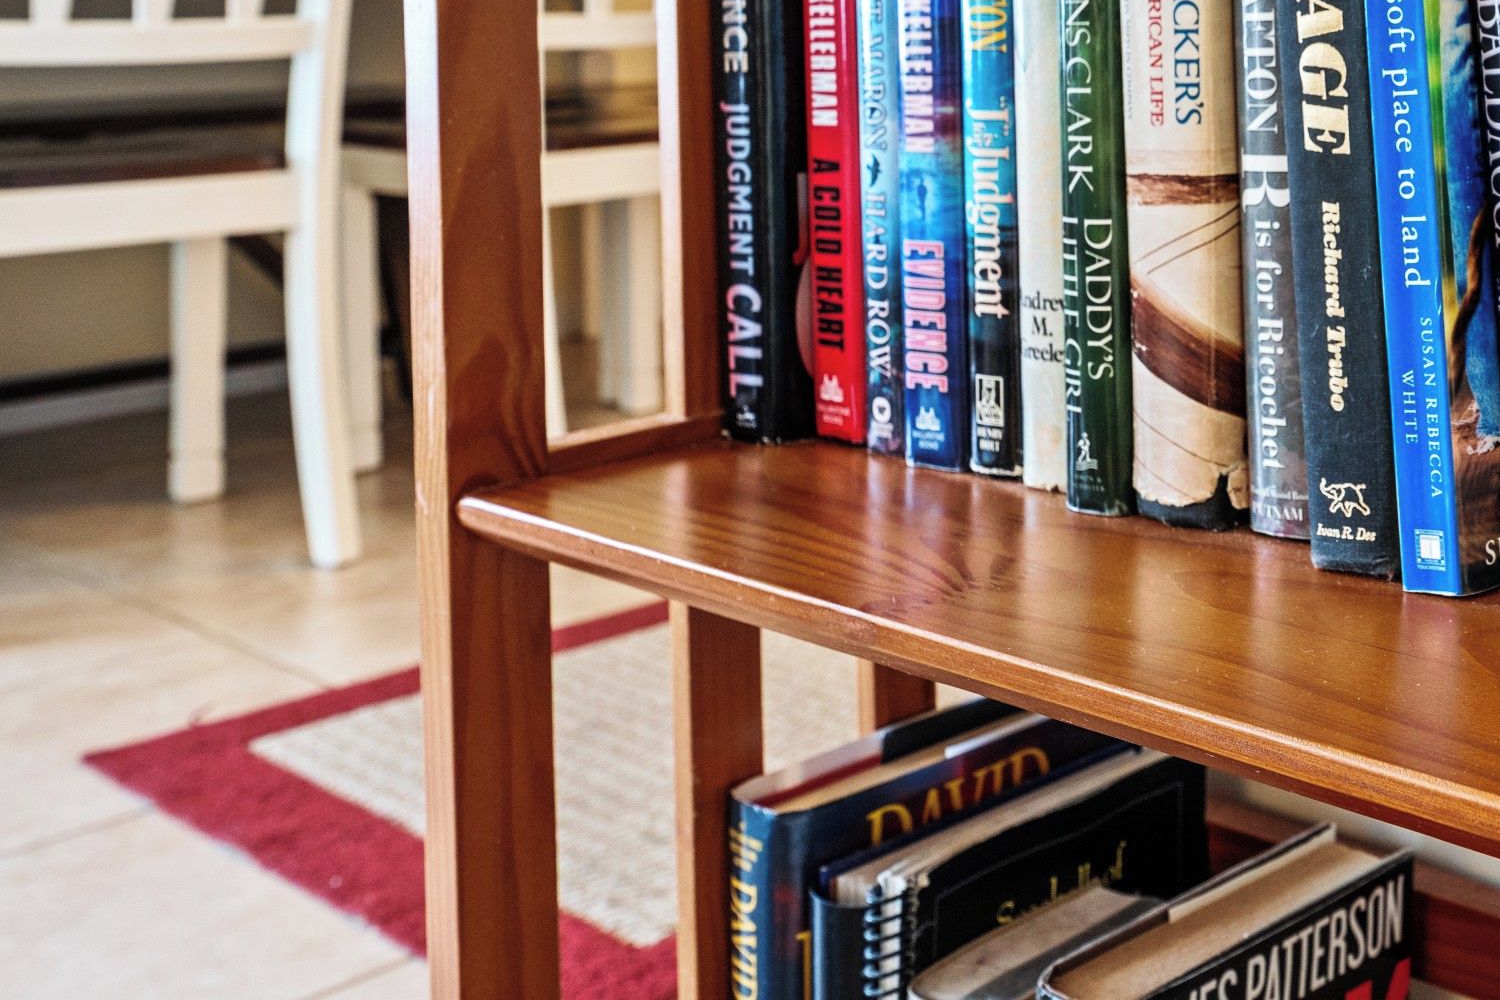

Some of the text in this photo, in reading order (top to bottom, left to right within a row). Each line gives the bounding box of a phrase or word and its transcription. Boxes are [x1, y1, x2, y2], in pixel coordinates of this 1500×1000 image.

[1066, 65, 1095, 194] CLARK
[1149, 76, 1164, 127] LIFE
[1383, 66, 1418, 154] place
[720, 100, 754, 276] JUDGMENT
[865, 191, 889, 290] HARD
[965, 136, 1016, 319] Judgment
[1255, 220, 1281, 248] is
[1398, 167, 1416, 200] to
[811, 157, 845, 352] A COLD HEART
[1083, 218, 1114, 381] DADDY'S
[1254, 256, 1283, 312] for
[1321, 201, 1346, 412] Richard Trubo
[1401, 213, 1431, 289] land
[726, 283, 765, 399] CALL
[866, 298, 894, 380] ROW
[903, 238, 949, 393] EVIDENCE
[1031, 316, 1053, 337] M.
[1062, 216, 1083, 415] LITTLE GIRL
[1256, 317, 1288, 471] Ricochet
[1401, 369, 1418, 445] WHITE
[1420, 316, 1442, 499] SUSAN REBECCA
[1316, 523, 1340, 538] Ivan
[1341, 526, 1354, 540] R.
[1246, 874, 1406, 1000] PATTERSON
